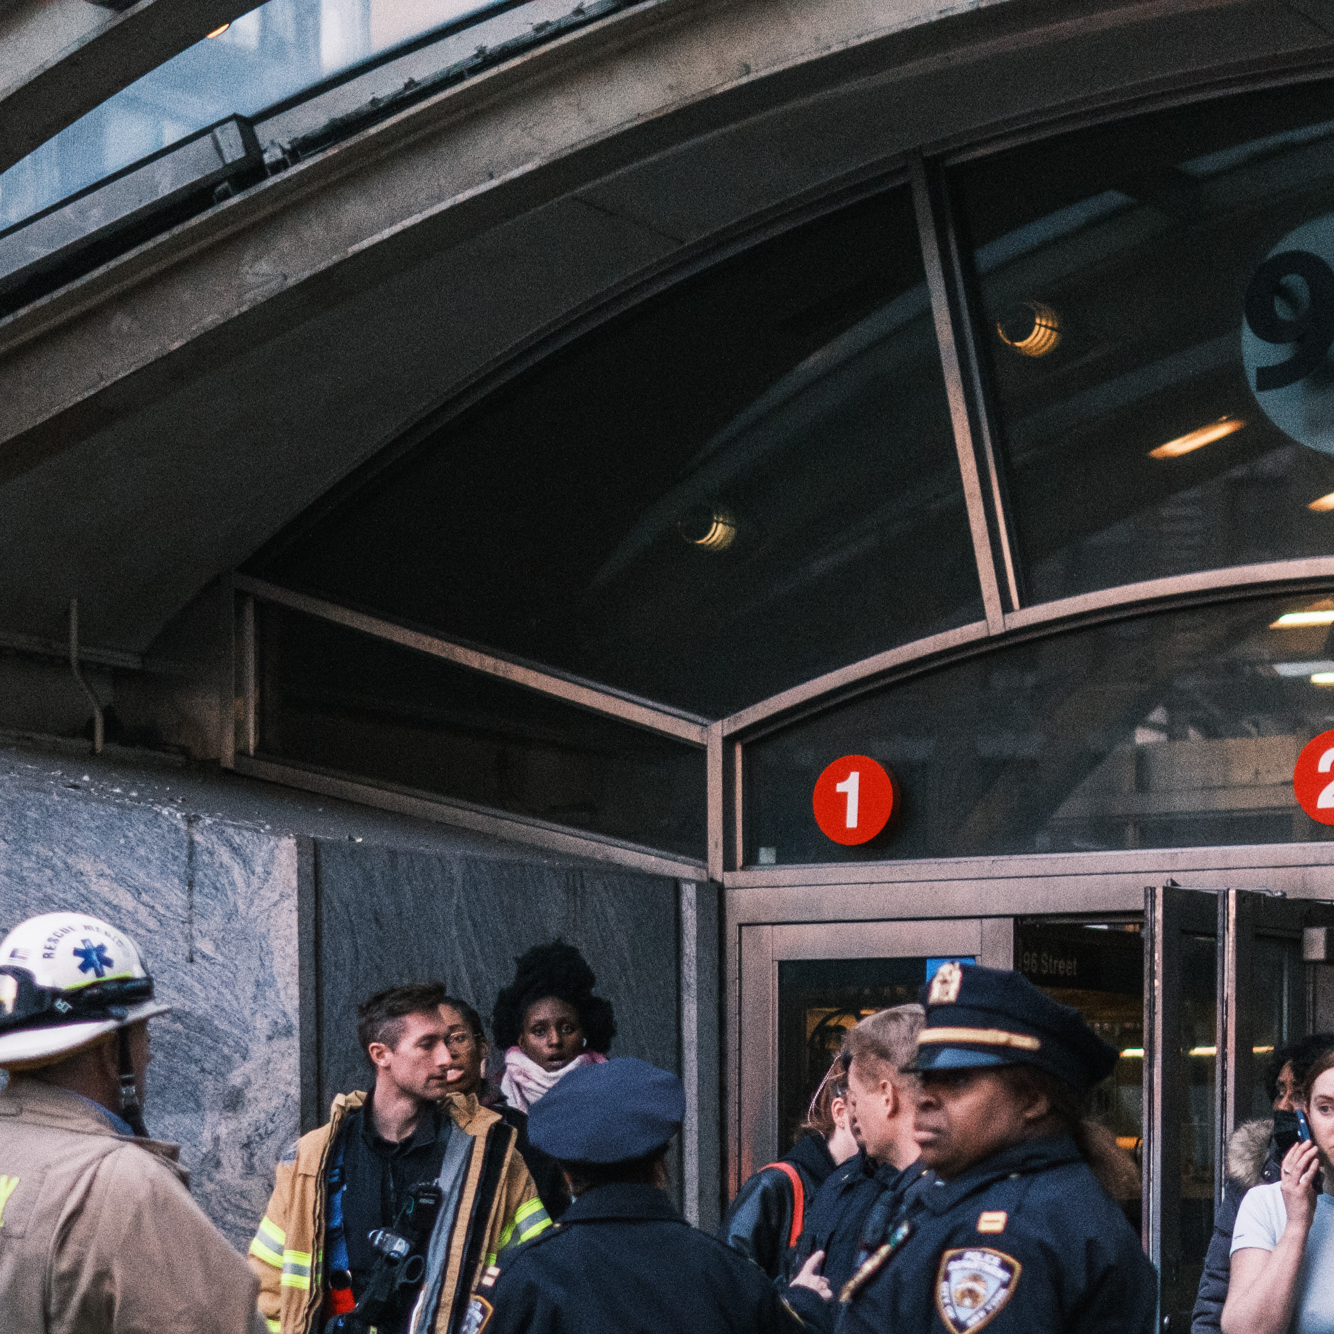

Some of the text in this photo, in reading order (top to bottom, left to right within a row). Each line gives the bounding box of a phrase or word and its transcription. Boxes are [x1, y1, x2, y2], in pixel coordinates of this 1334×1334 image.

[835, 771, 860, 828] 1
[1022, 951, 1078, 976] 96 Street
